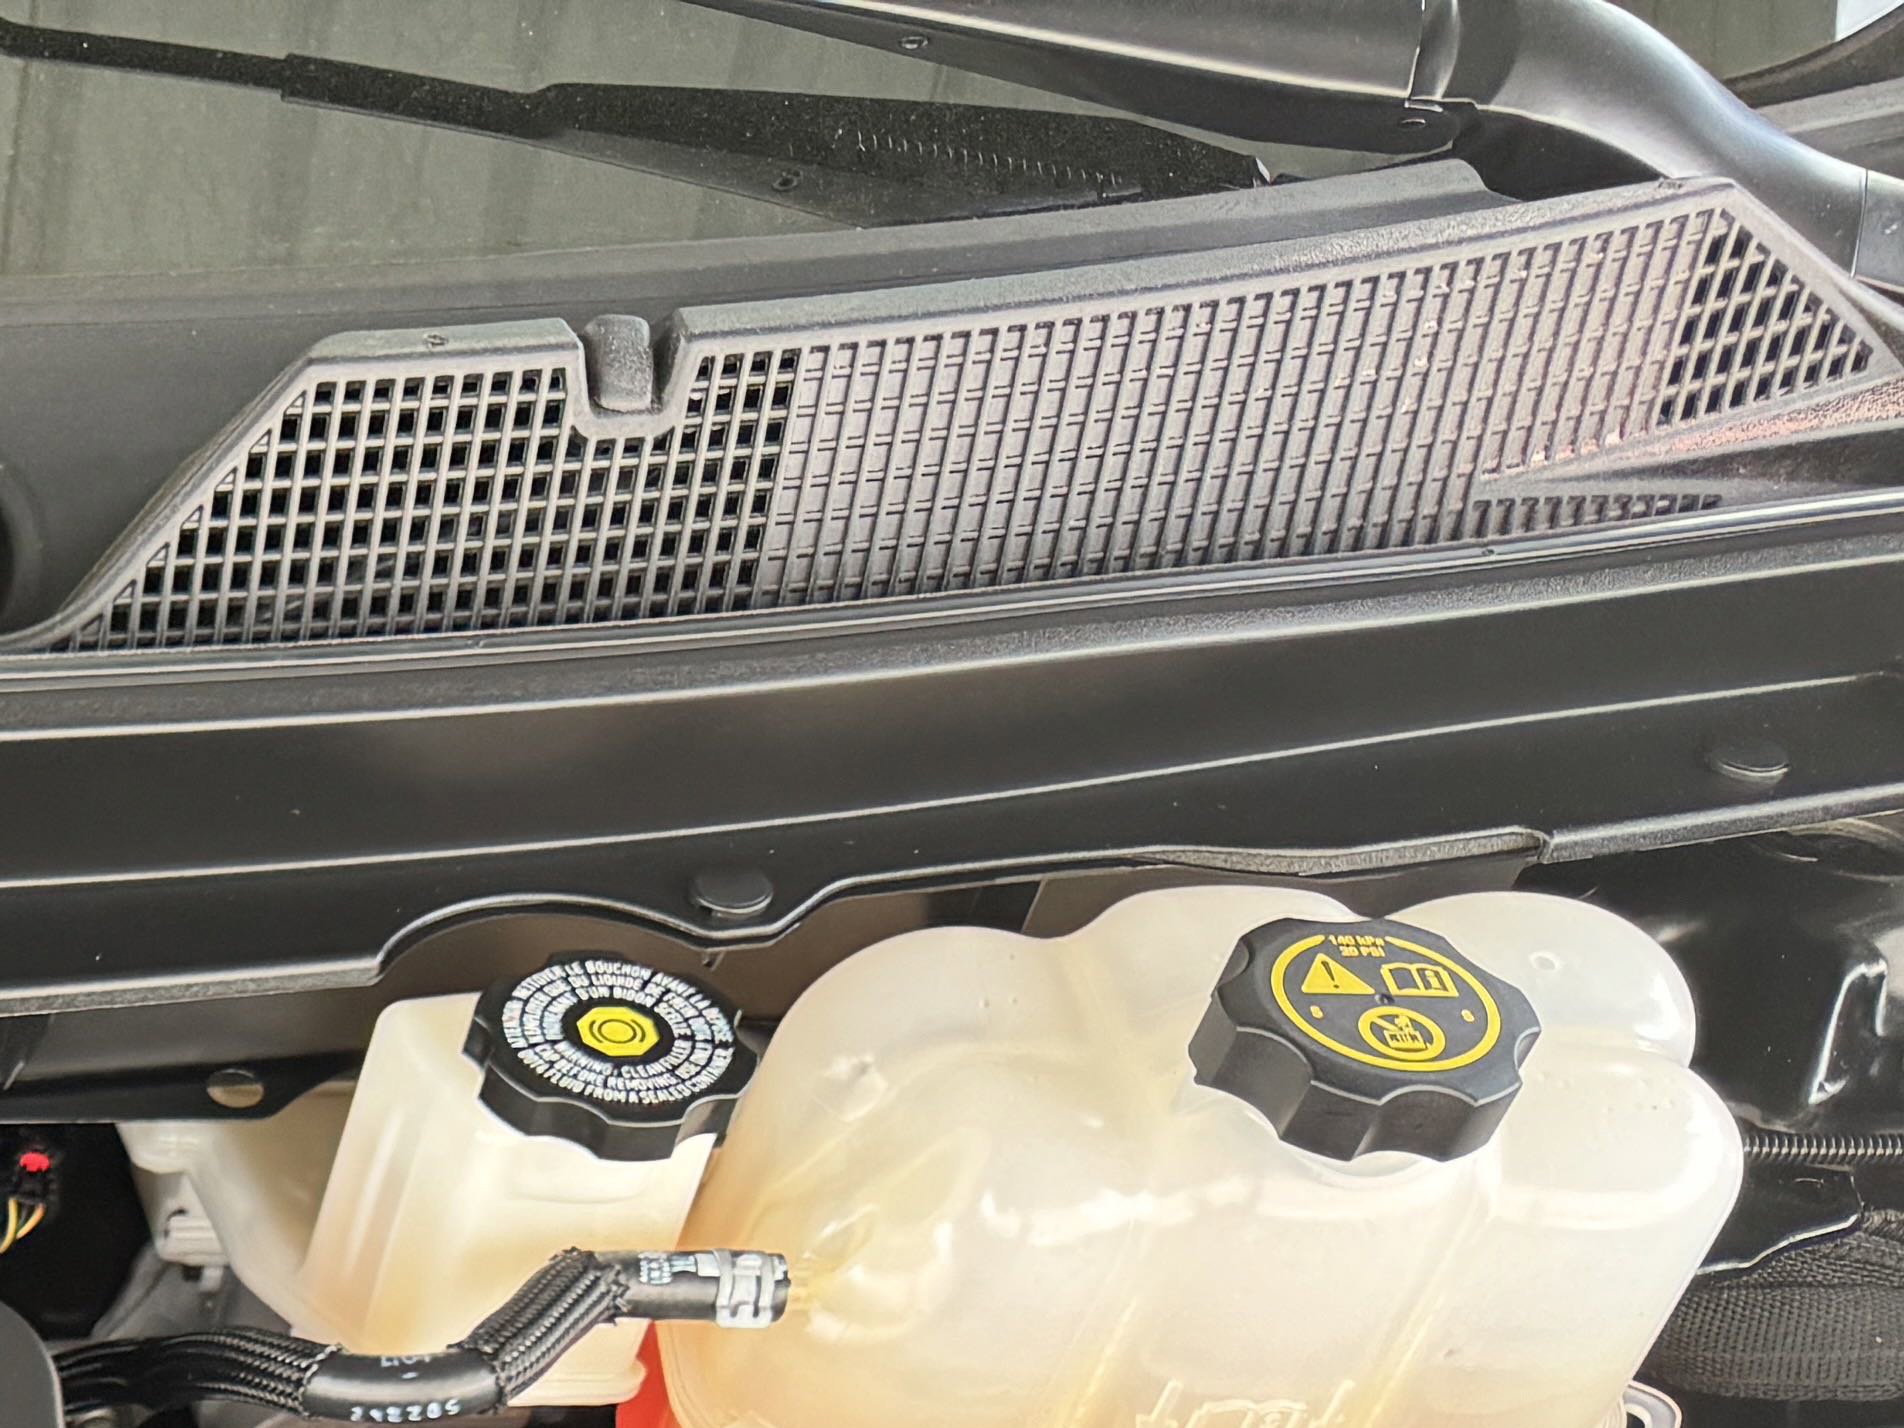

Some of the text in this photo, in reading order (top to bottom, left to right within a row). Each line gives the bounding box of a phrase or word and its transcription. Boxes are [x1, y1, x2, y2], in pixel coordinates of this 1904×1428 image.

[565, 962, 583, 974] LE
[586, 961, 651, 979] BOUCHON
[652, 973, 694, 997] AVANT
[568, 975, 589, 987] DU
[592, 974, 642, 990] LIQUIDE
[644, 983, 665, 997] DE
[576, 986, 609, 1000] D'UN
[614, 987, 656, 1007] BIDON
[554, 1059, 604, 1086] BEFORE
[621, 1062, 666, 1077] CLEAN
[584, 1085, 626, 1102] FROM
[629, 1092, 638, 1102] A
[639, 1084, 691, 1103] SEALED
